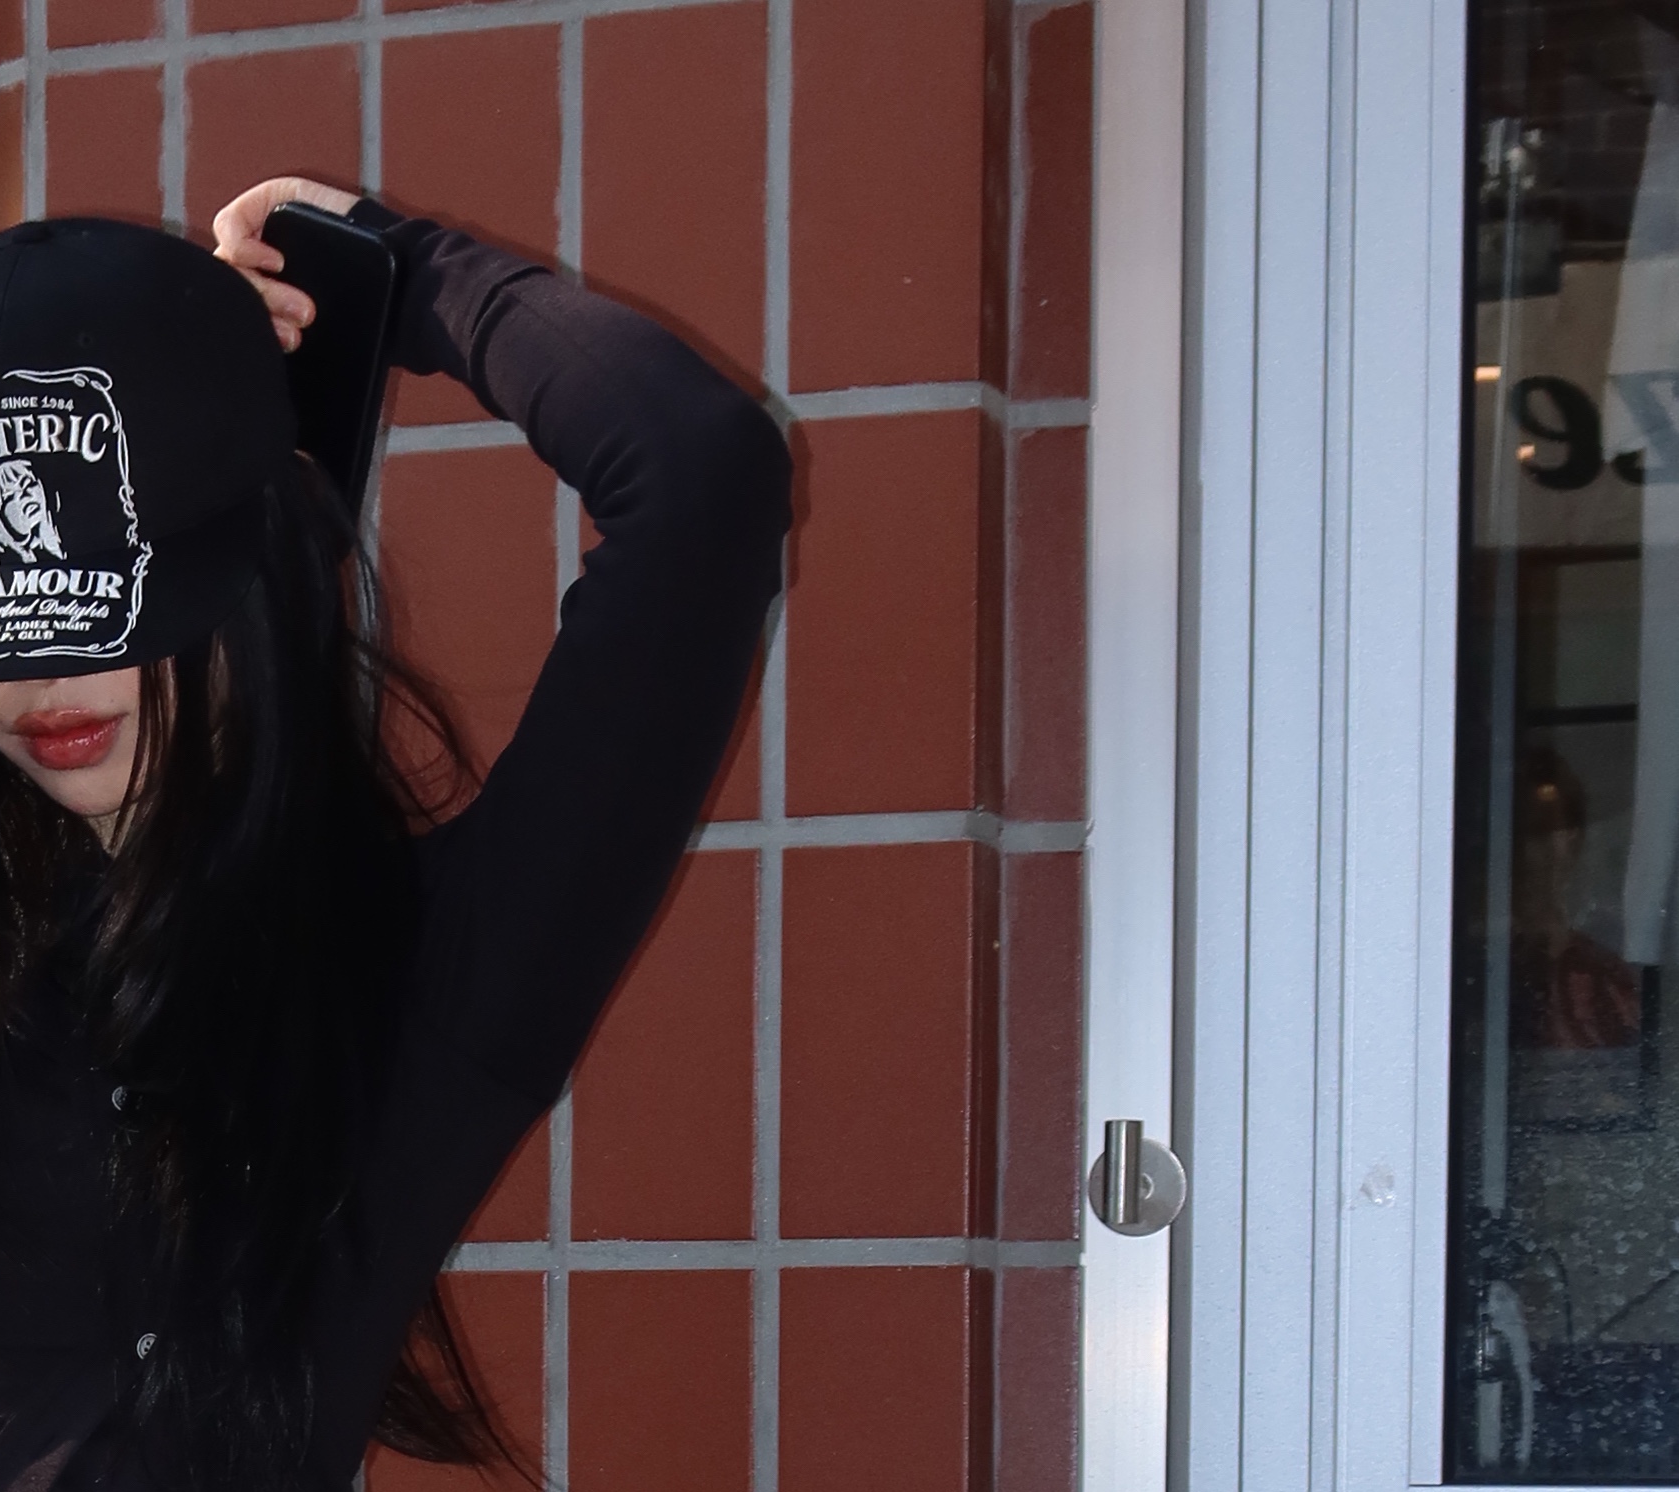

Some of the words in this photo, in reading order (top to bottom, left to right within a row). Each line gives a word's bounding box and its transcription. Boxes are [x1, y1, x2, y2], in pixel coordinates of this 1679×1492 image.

[1, 396, 38, 410] SINCE
[41, 396, 74, 412] 1984
[37, 598, 109, 622] Delights
[5, 619, 50, 632] LADIES
[52, 619, 93, 632] NIGHT
